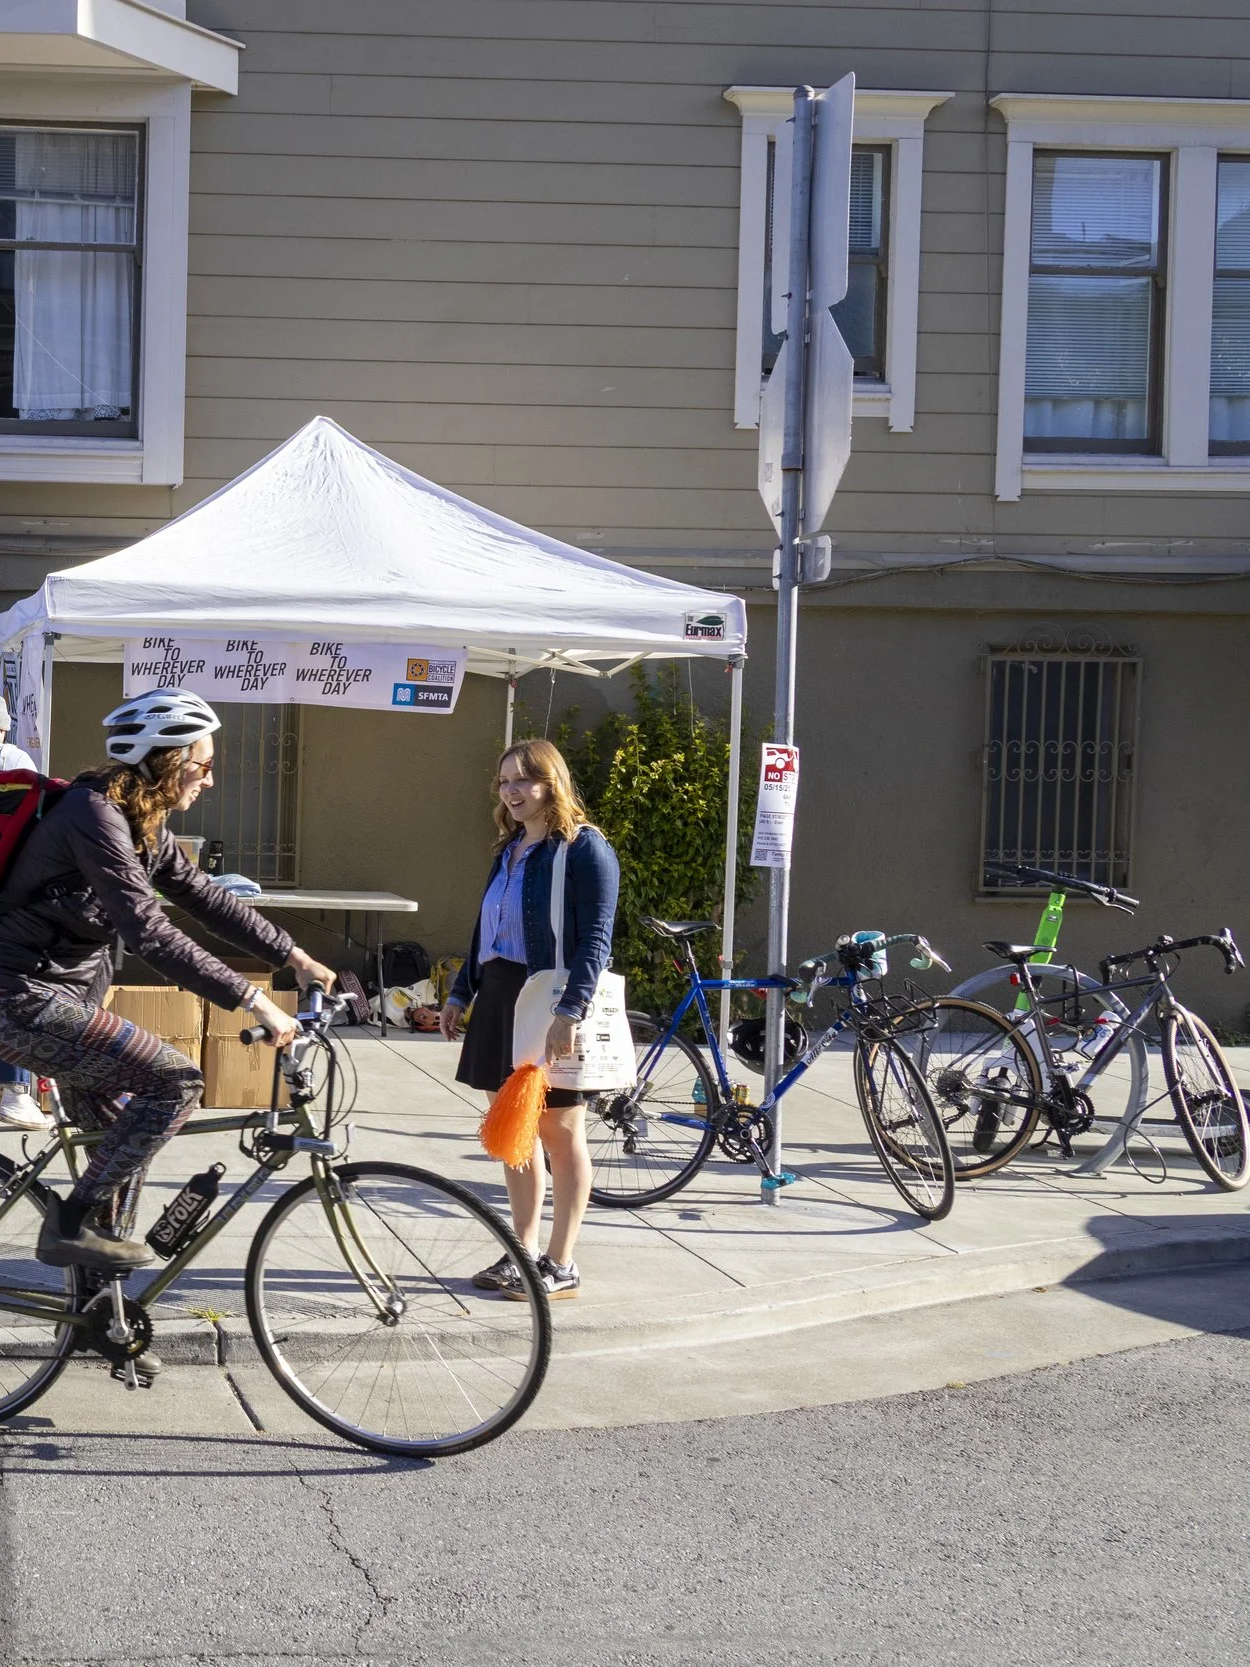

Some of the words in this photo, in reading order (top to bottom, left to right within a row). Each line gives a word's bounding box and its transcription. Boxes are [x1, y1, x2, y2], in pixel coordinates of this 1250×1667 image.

[685, 623, 722, 637] Eurmax
[143, 637, 175, 649] BIKE
[226, 640, 258, 652] BIKE
[309, 642, 344, 656] BIKE
[163, 648, 181, 661] TO
[247, 650, 264, 664] TO
[131, 660, 206, 676] WHEREVER
[330, 656, 347, 669] TO
[428, 664, 455, 674] BICYCLE
[214, 662, 287, 679] WHEREVER
[295, 668, 372, 682] WHEREVER
[157, 674, 186, 688] DAY
[240, 677, 269, 691] DAY
[321, 682, 351, 695] DAY
[418, 692, 449, 702] SFMTA
[768, 771, 780, 780] NO
[166, 1186, 205, 1229] FOLK
